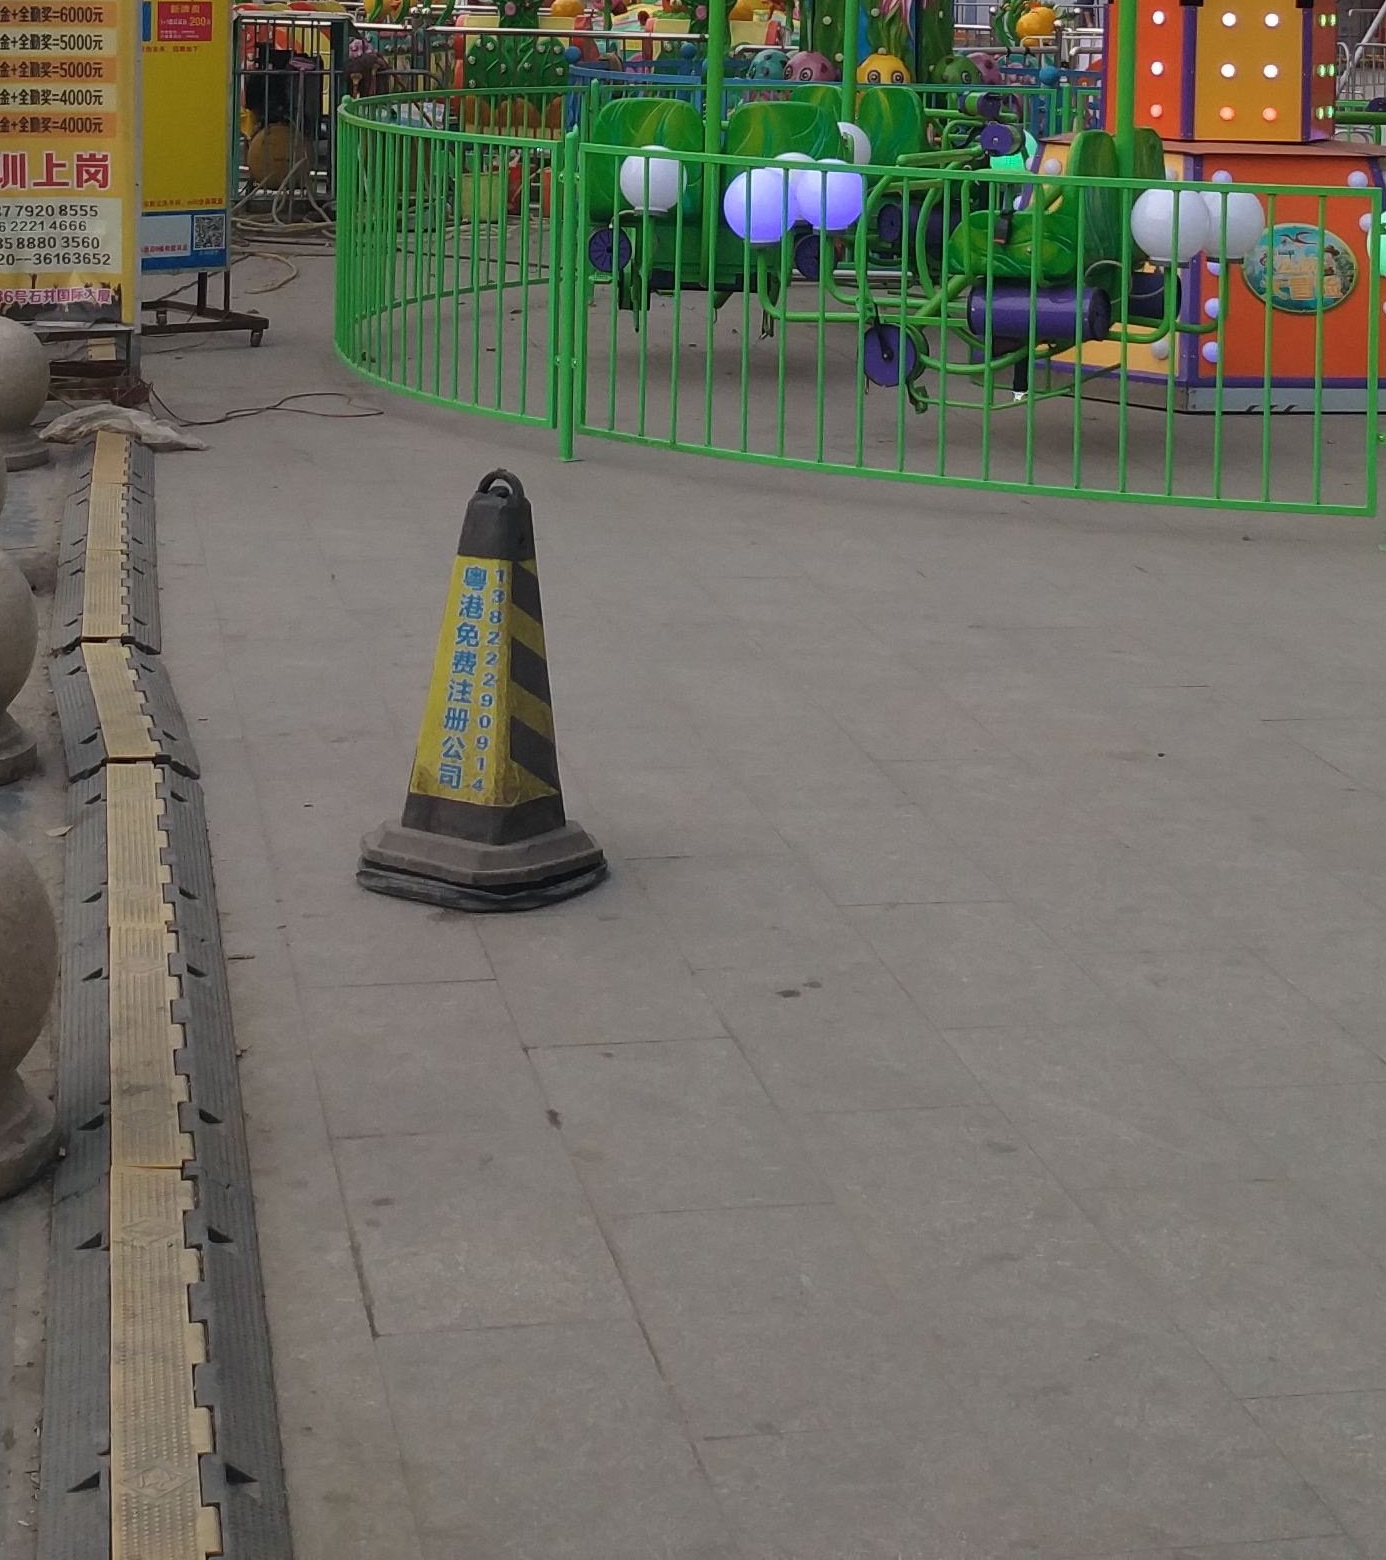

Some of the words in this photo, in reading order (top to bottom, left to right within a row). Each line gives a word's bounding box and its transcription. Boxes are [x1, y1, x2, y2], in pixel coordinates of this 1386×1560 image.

[438, 566, 488, 791] 粤港免费注册公司
[471, 568, 507, 793] 13822290914
